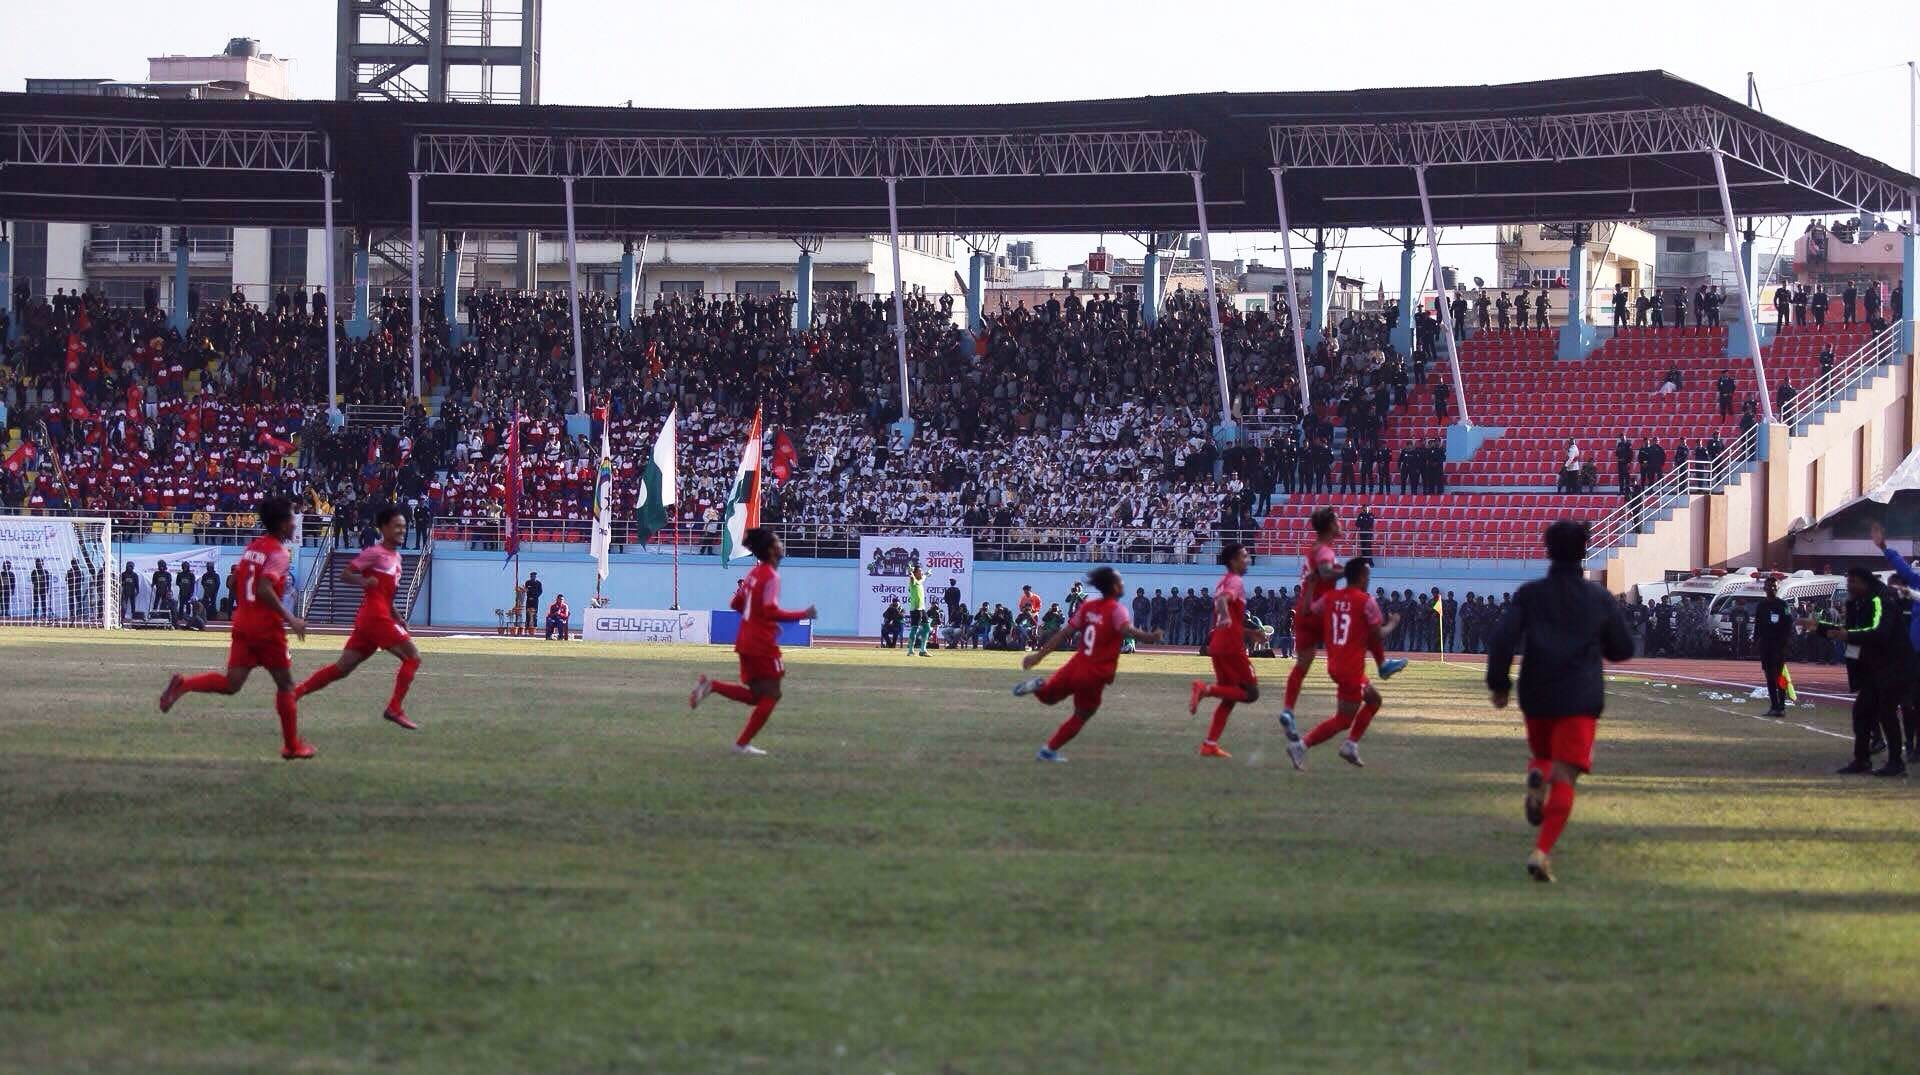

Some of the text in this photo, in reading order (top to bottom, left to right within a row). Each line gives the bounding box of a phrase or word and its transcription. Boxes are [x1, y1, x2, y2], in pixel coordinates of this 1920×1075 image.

[927, 557, 964, 569] आवास
[597, 618, 676, 632] CELLPAY
[1332, 612, 1351, 645] 13
[1084, 625, 1096, 656] 9
